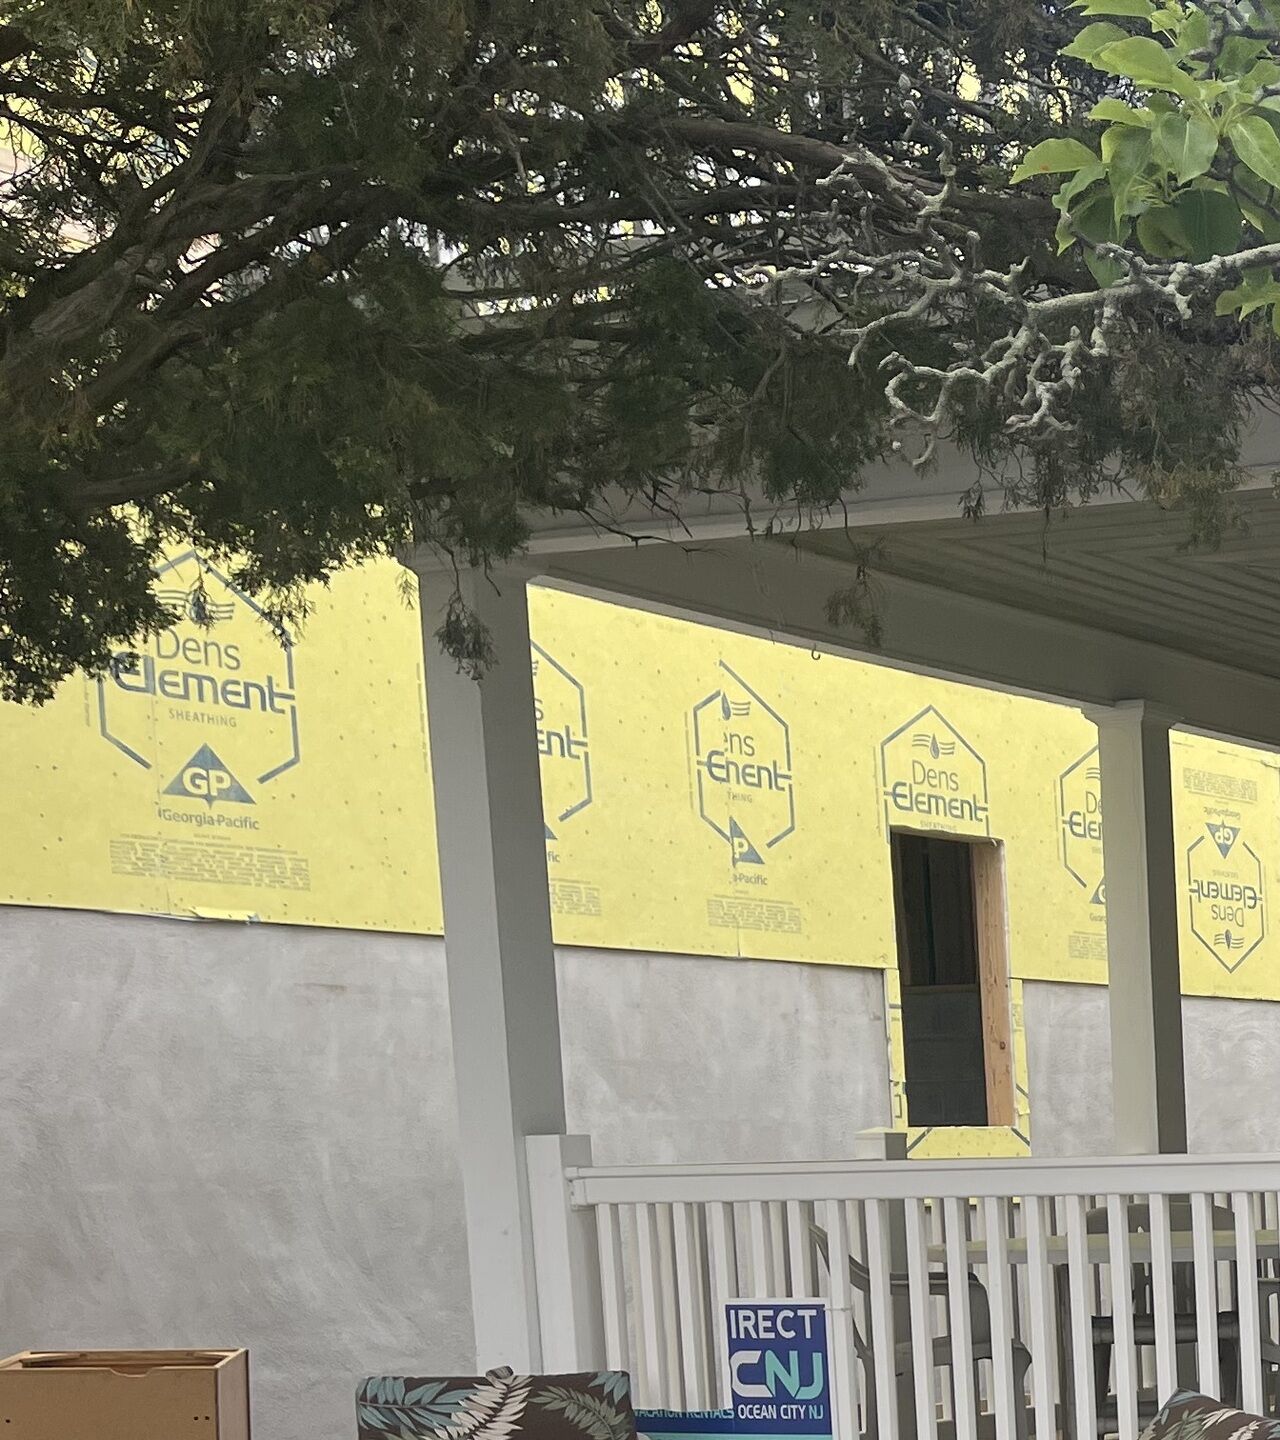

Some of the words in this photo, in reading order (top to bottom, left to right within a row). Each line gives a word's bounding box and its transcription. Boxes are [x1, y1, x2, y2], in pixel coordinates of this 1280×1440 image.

[156, 626, 241, 671] Dens
[110, 652, 296, 714] Element
[168, 707, 238, 729] SHEATHING
[182, 766, 232, 797] GP
[912, 759, 959, 792] Dens
[884, 781, 988, 823] Element
[1214, 827, 1234, 846] GP
[1189, 879, 1263, 909] Element
[1211, 903, 1244, 927] Dens
[729, 1309, 817, 1339] IRECT
[730, 1350, 823, 1400] CNJ
[738, 1404, 777, 1420] OCEAN
[780, 1404, 806, 1420] CITY
[808, 1404, 824, 1420] NJ
